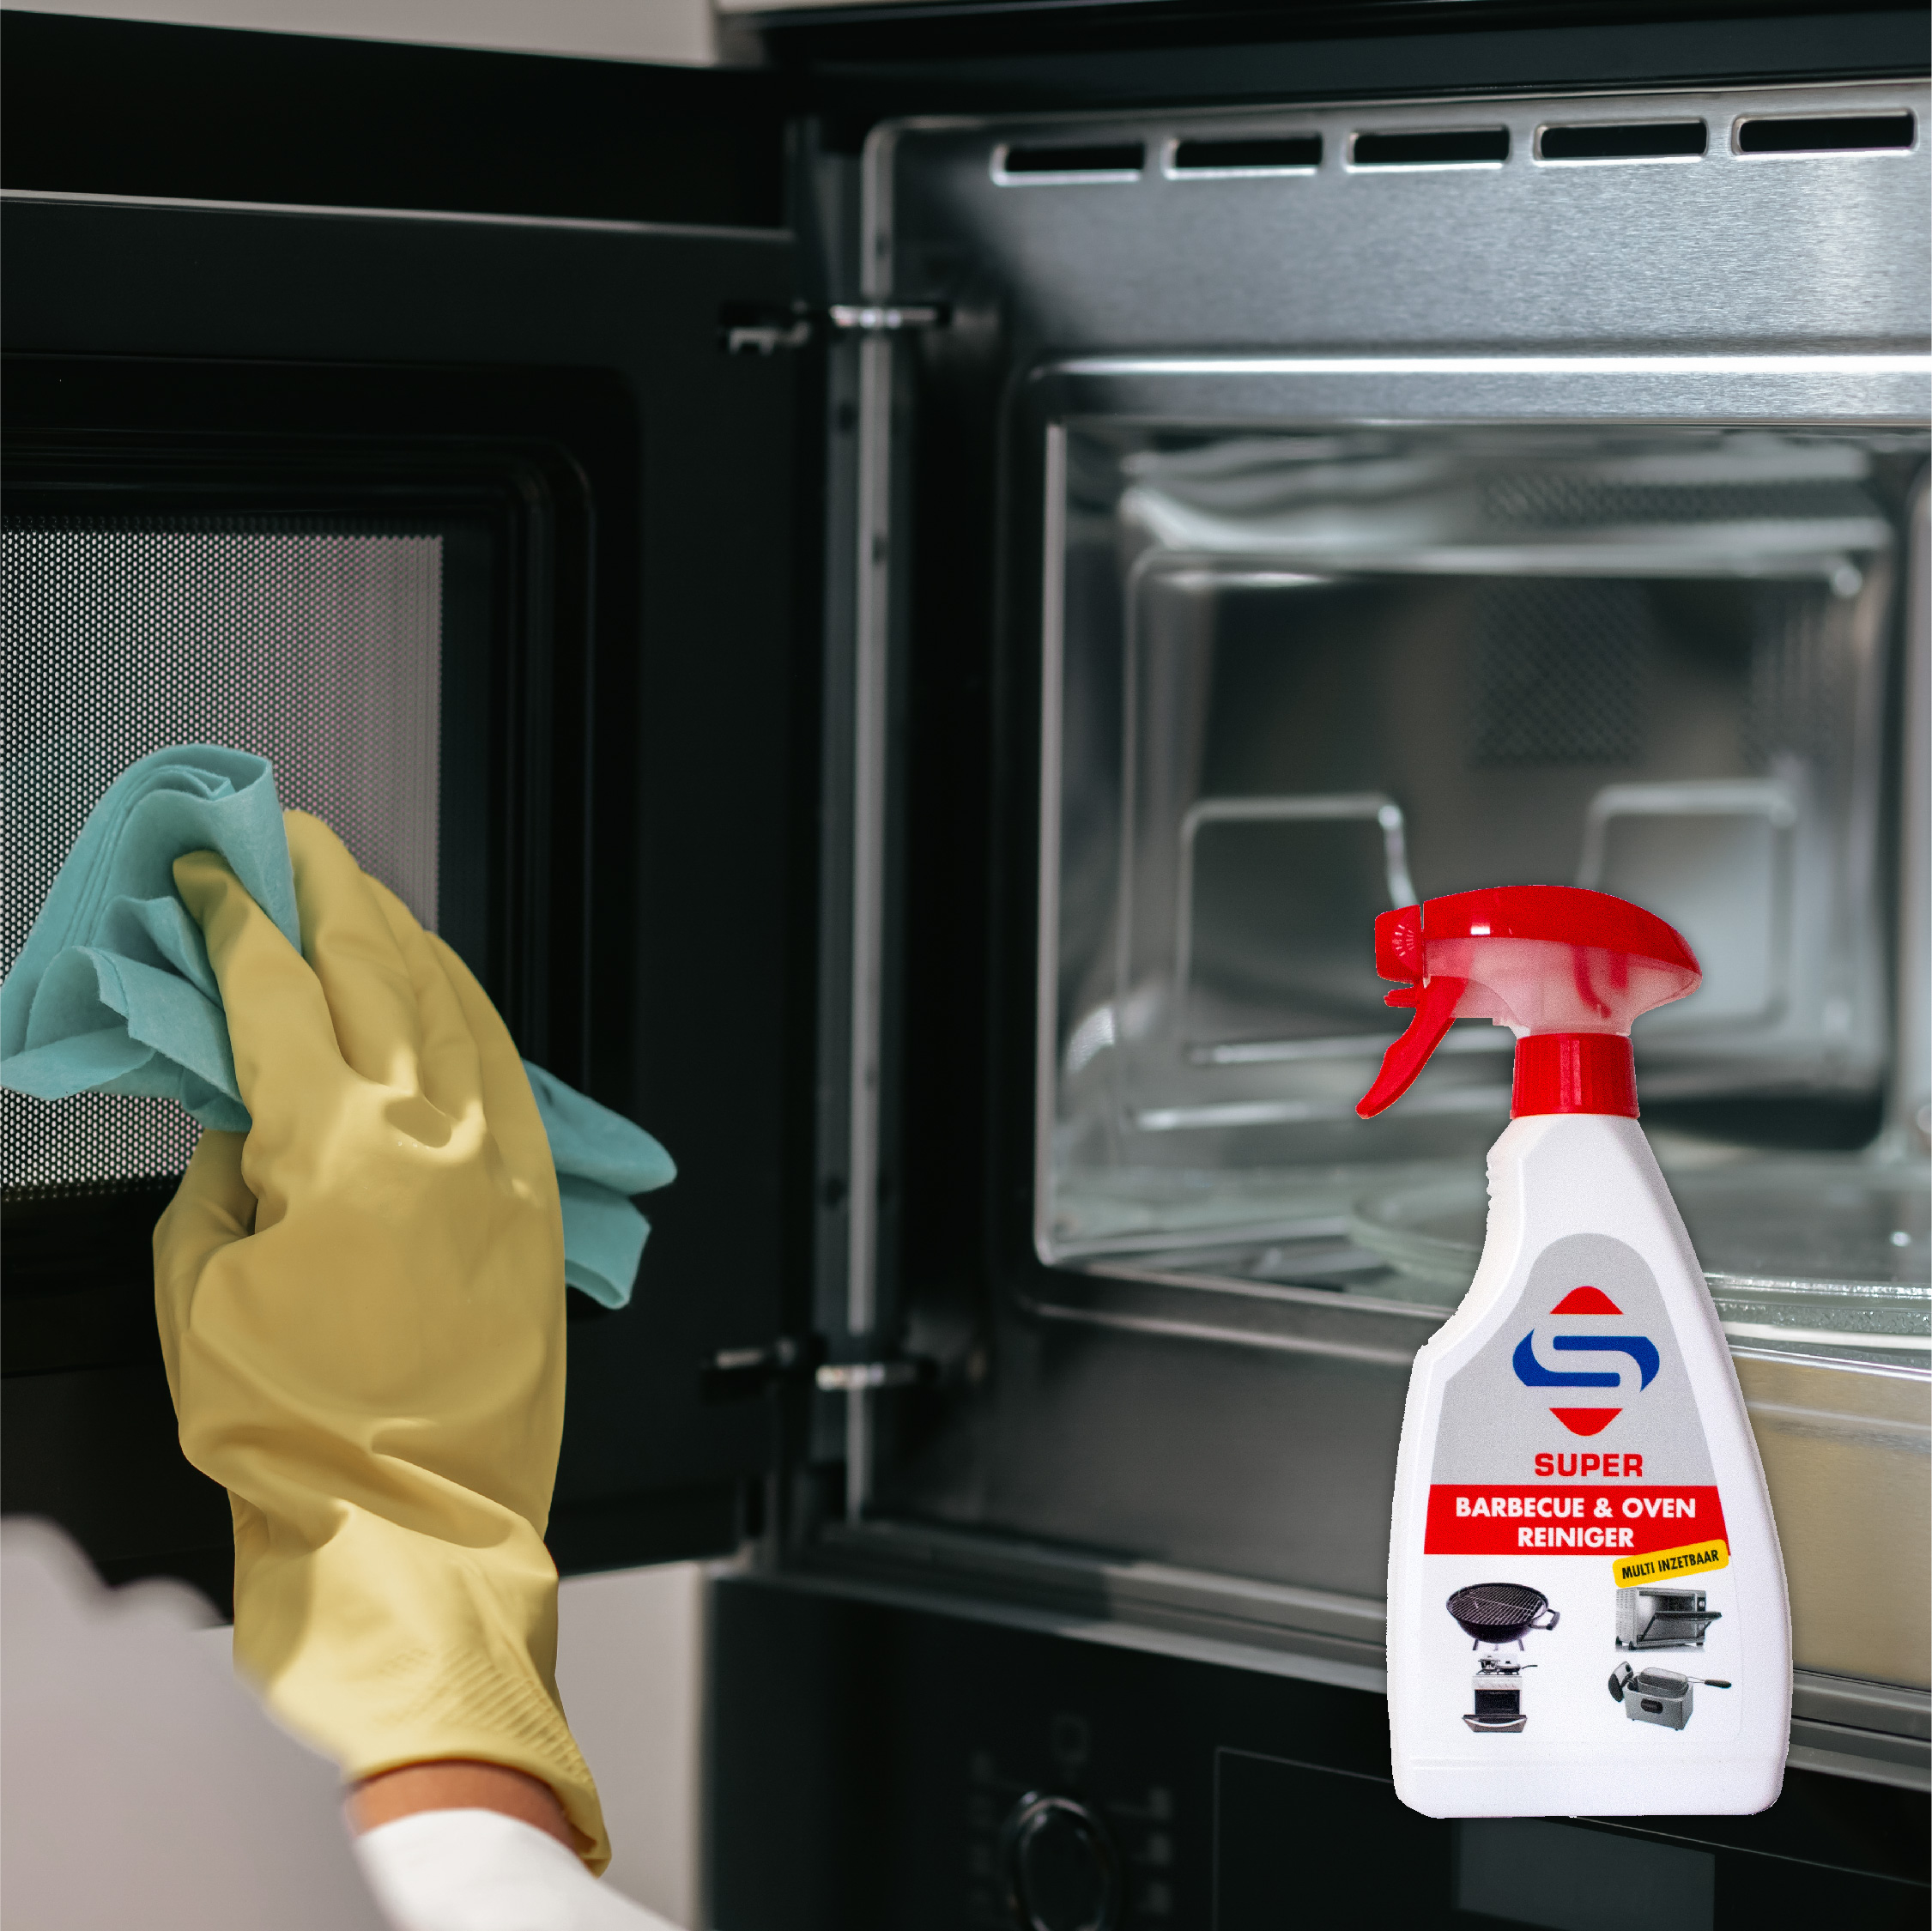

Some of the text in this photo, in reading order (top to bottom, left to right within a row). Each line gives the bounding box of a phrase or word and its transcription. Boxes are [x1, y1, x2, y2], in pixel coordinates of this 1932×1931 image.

[1535, 1453, 1643, 1477] SUPER
[1456, 1498, 1696, 1518] BARBECUE & OVEN
[1517, 1528, 1634, 1548] REINIGER
[1621, 1549, 1719, 1580] MULTI INZETBAAR
